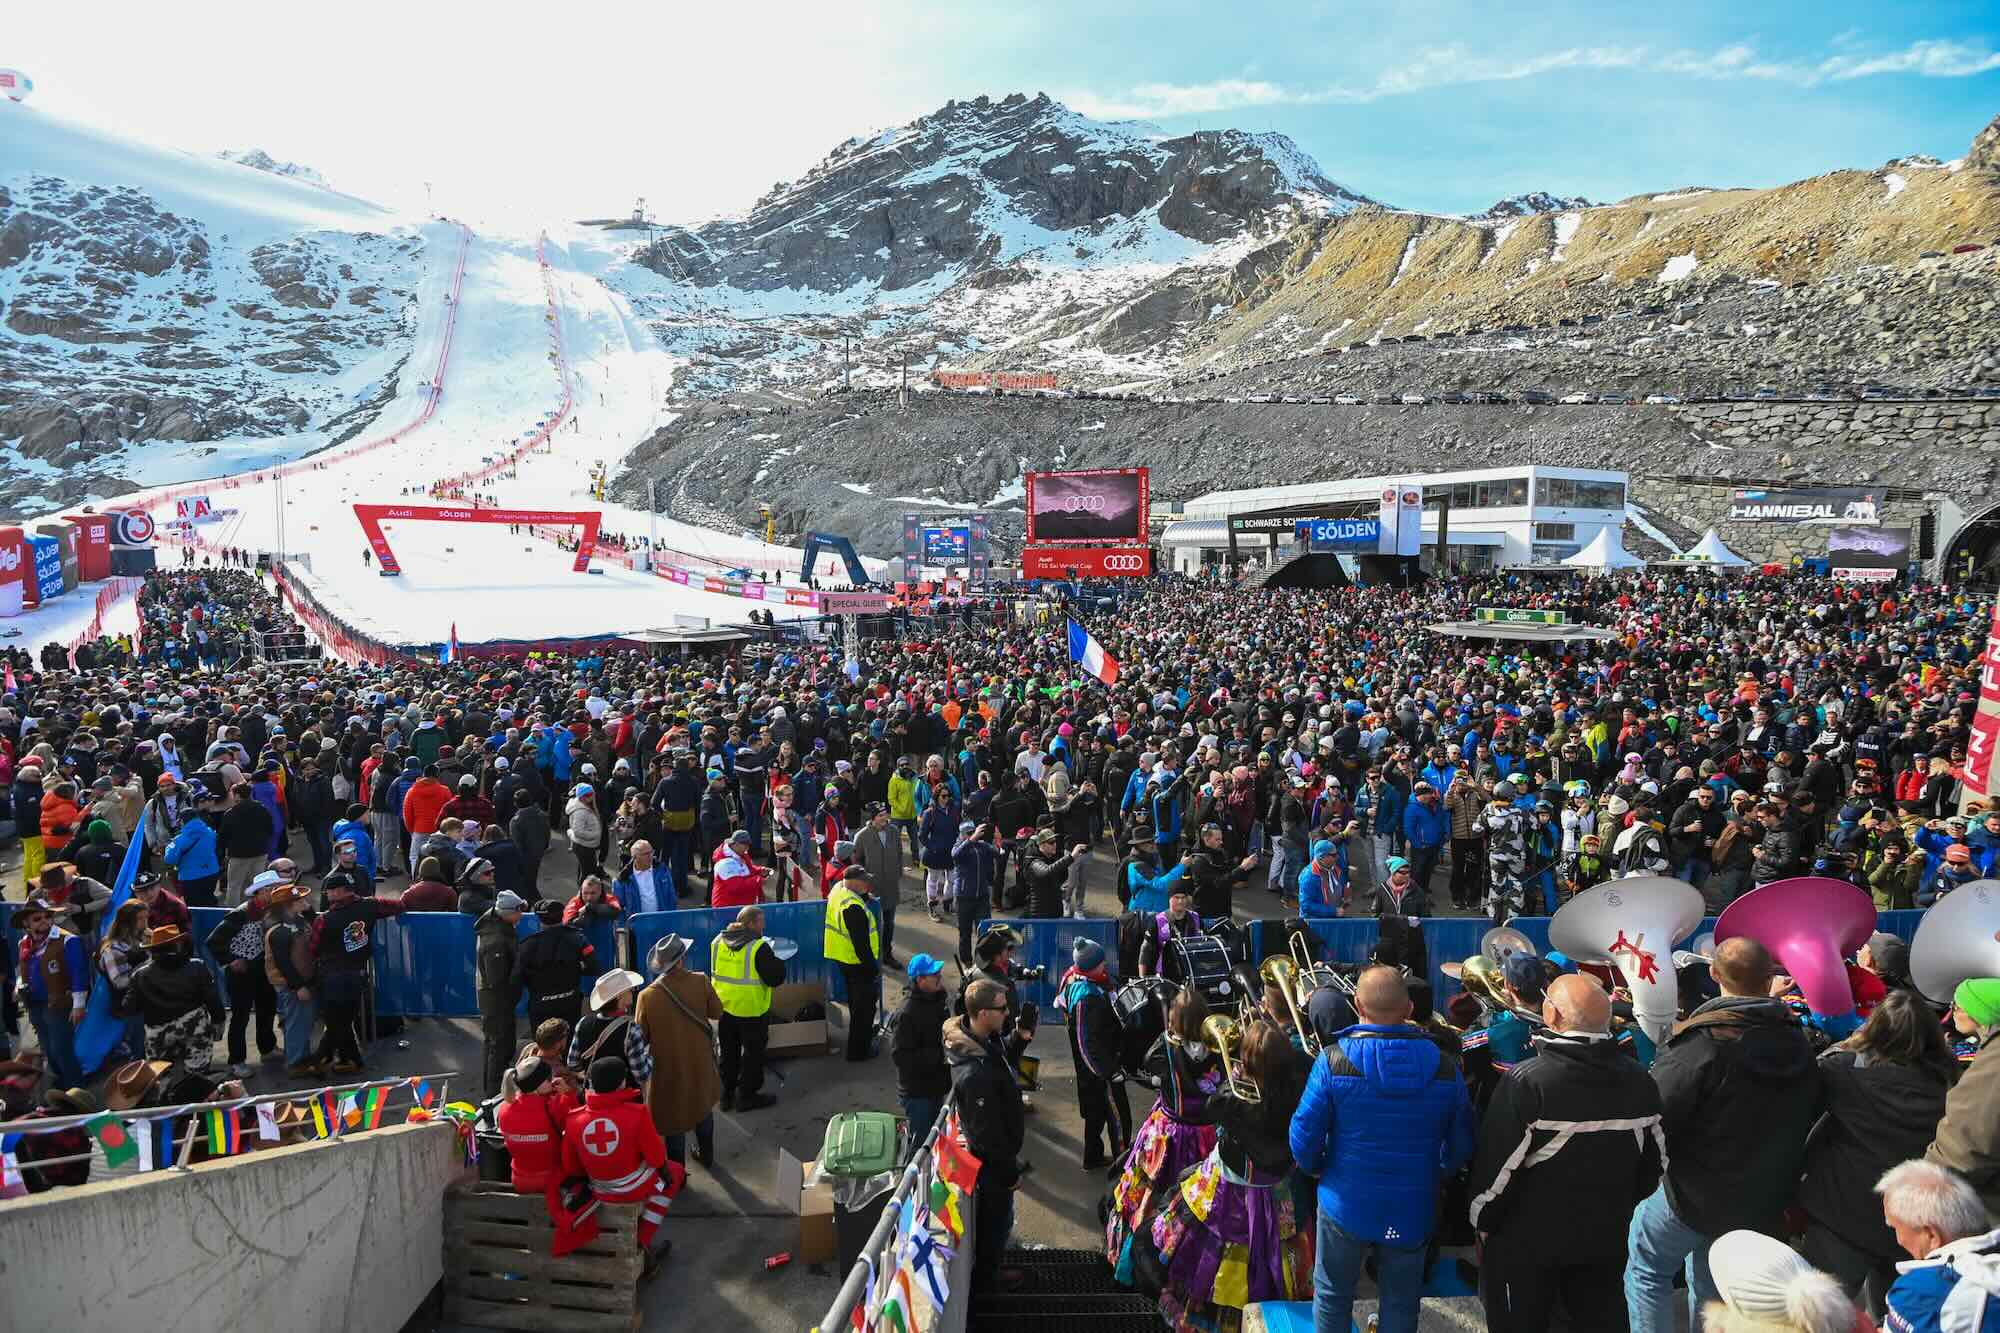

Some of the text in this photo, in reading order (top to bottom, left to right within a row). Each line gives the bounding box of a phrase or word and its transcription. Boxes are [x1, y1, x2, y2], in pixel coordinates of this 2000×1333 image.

[388, 509, 413, 517] Audi
[438, 509, 471, 519] SÖLDEN
[1730, 504, 1836, 518] HANNIBAL
[1244, 518, 1282, 528] SCHWARZE
[1317, 521, 1377, 541] SÖLDEN
[927, 556, 966, 564] LONGINES
[832, 600, 861, 608] SPECIAL
